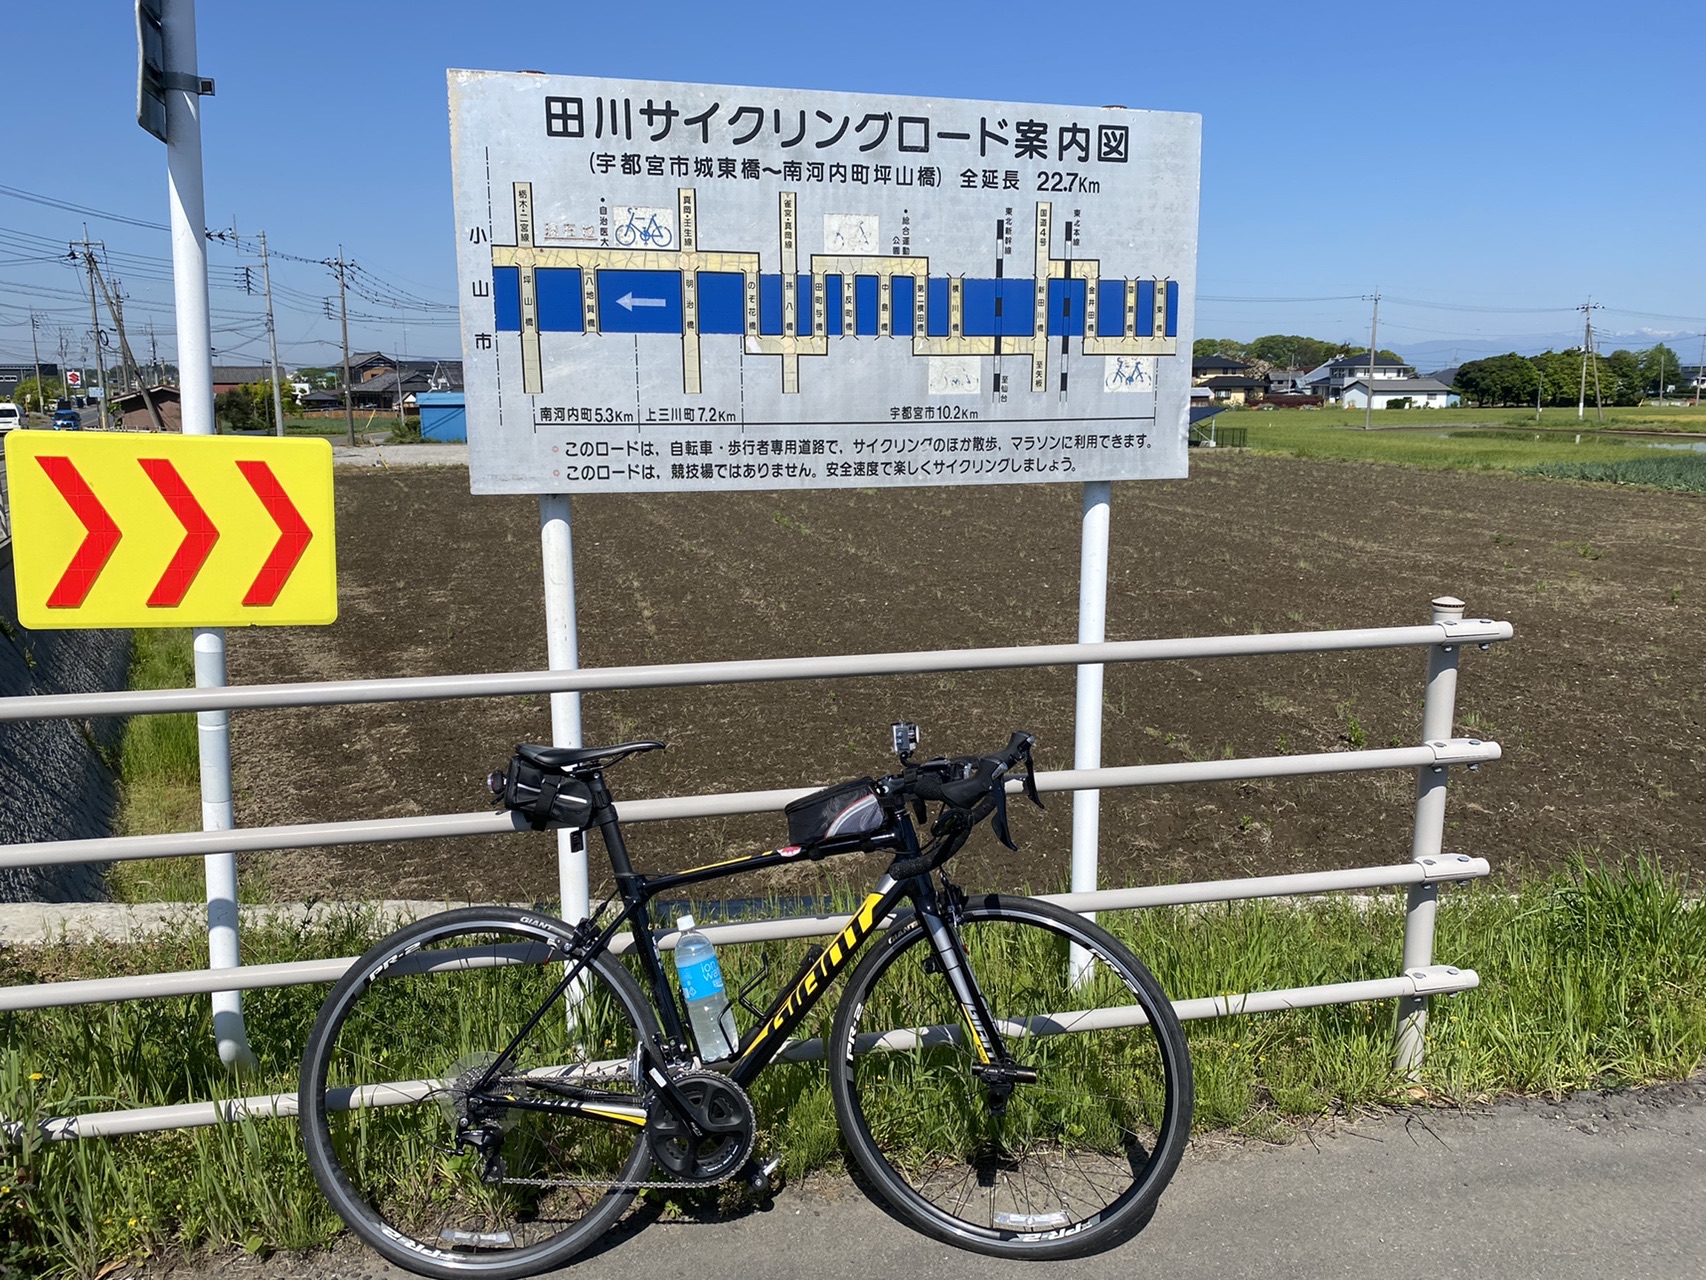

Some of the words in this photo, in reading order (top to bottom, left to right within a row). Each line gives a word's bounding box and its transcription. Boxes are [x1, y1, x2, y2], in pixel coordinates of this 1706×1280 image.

[545, 95, 1129, 163] 田川サイクリングロード案内図
[960, 168, 1020, 191] 全延長
[1037, 171, 1101, 194] 22.7Km
[599, 206, 609, 247] 自治医大
[1004, 207, 1013, 255] 東北新幹線
[1040, 209, 1048, 247] 国道4号
[523, 275, 534, 327] 坪山橋
[685, 279, 695, 330] 明治橋
[952, 285, 960, 332] 横川橋
[1000, 375, 1009, 403] 至仙台
[368, 941, 421, 982] PR-2
[700, 960, 716, 974] ion
[846, 1002, 864, 1061] PR-2
